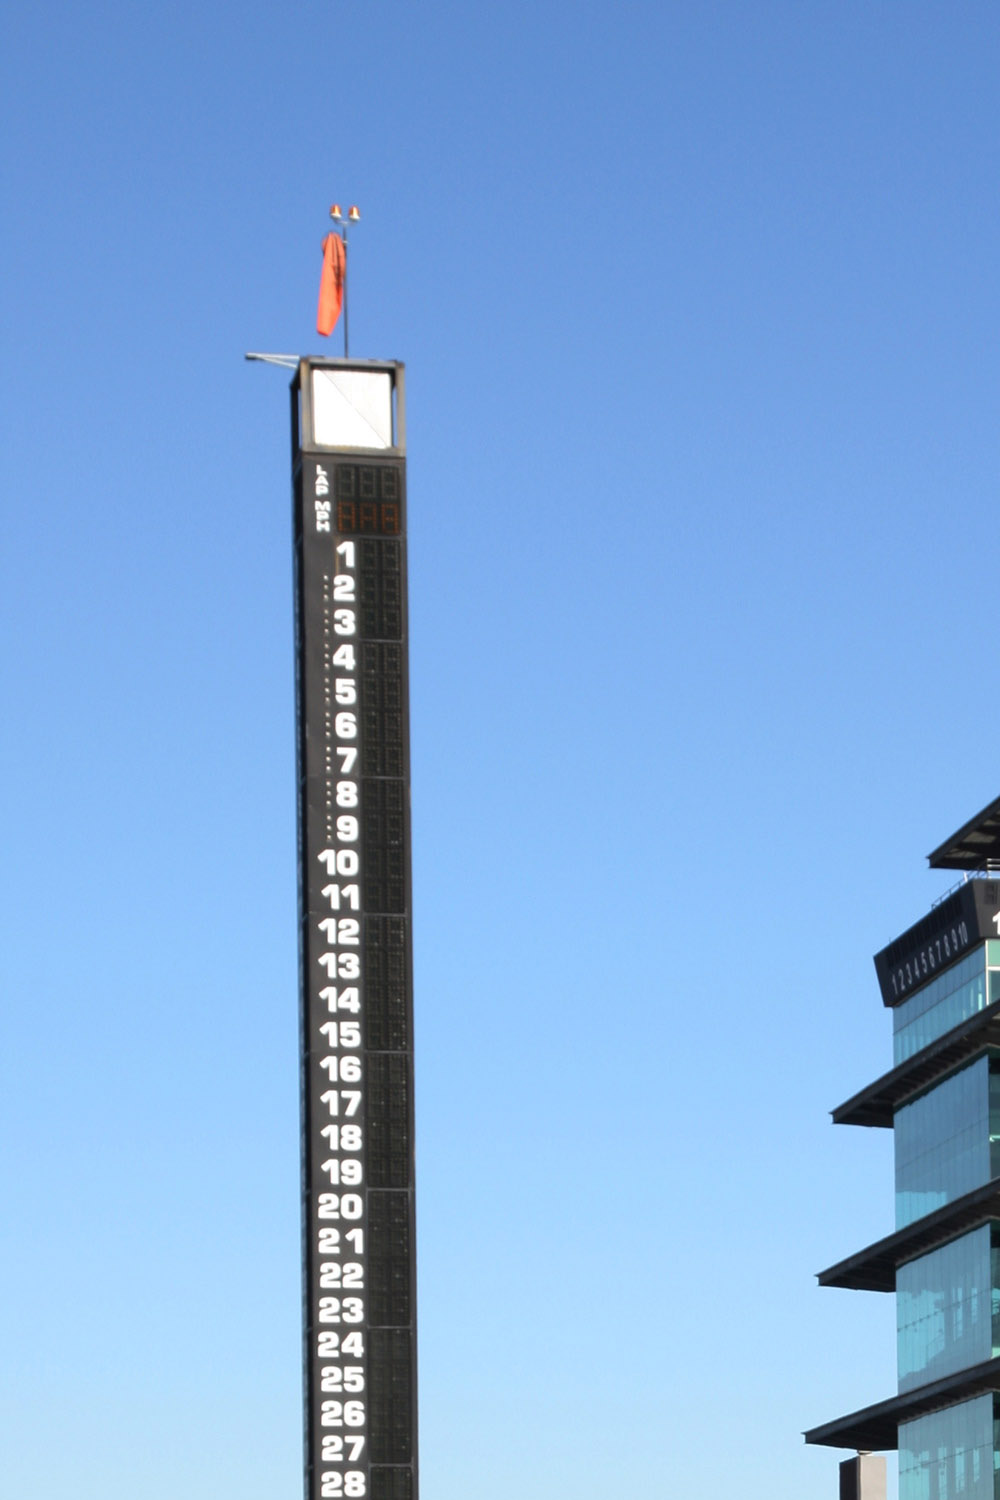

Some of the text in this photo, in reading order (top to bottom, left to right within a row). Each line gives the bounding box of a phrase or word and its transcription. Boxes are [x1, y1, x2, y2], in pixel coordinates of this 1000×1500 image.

[315, 465, 329, 496] LAP
[314, 501, 331, 532] MPH
[336, 541, 355, 568] 1
[333, 575, 356, 602] 2
[333, 609, 356, 636] 3
[332, 644, 357, 671] 4
[335, 678, 357, 705] 5
[335, 712, 358, 739] 6
[337, 747, 358, 774] 7
[335, 781, 358, 808] 8
[336, 815, 359, 842] 9
[318, 849, 359, 876] 10
[320, 884, 360, 911] 11
[318, 918, 360, 945] 12
[318, 953, 361, 979] 13
[892, 921, 968, 995] 1 2 3 4 5 6 7 8 9 10
[319, 987, 361, 1014] 14
[319, 1021, 362, 1048] 15
[320, 1056, 362, 1082] 16
[320, 1090, 362, 1116] 17
[320, 1125, 363, 1151] 18
[320, 1159, 363, 1185] 19
[318, 1193, 364, 1220] 20
[318, 1228, 364, 1255] 21
[319, 1262, 365, 1289] 22
[318, 1297, 365, 1323] 23
[318, 1331, 365, 1358] 24
[320, 1366, 365, 1392] 25
[321, 1400, 366, 1427] 26
[321, 1435, 366, 1462] 27
[320, 1470, 367, 1497] 28
